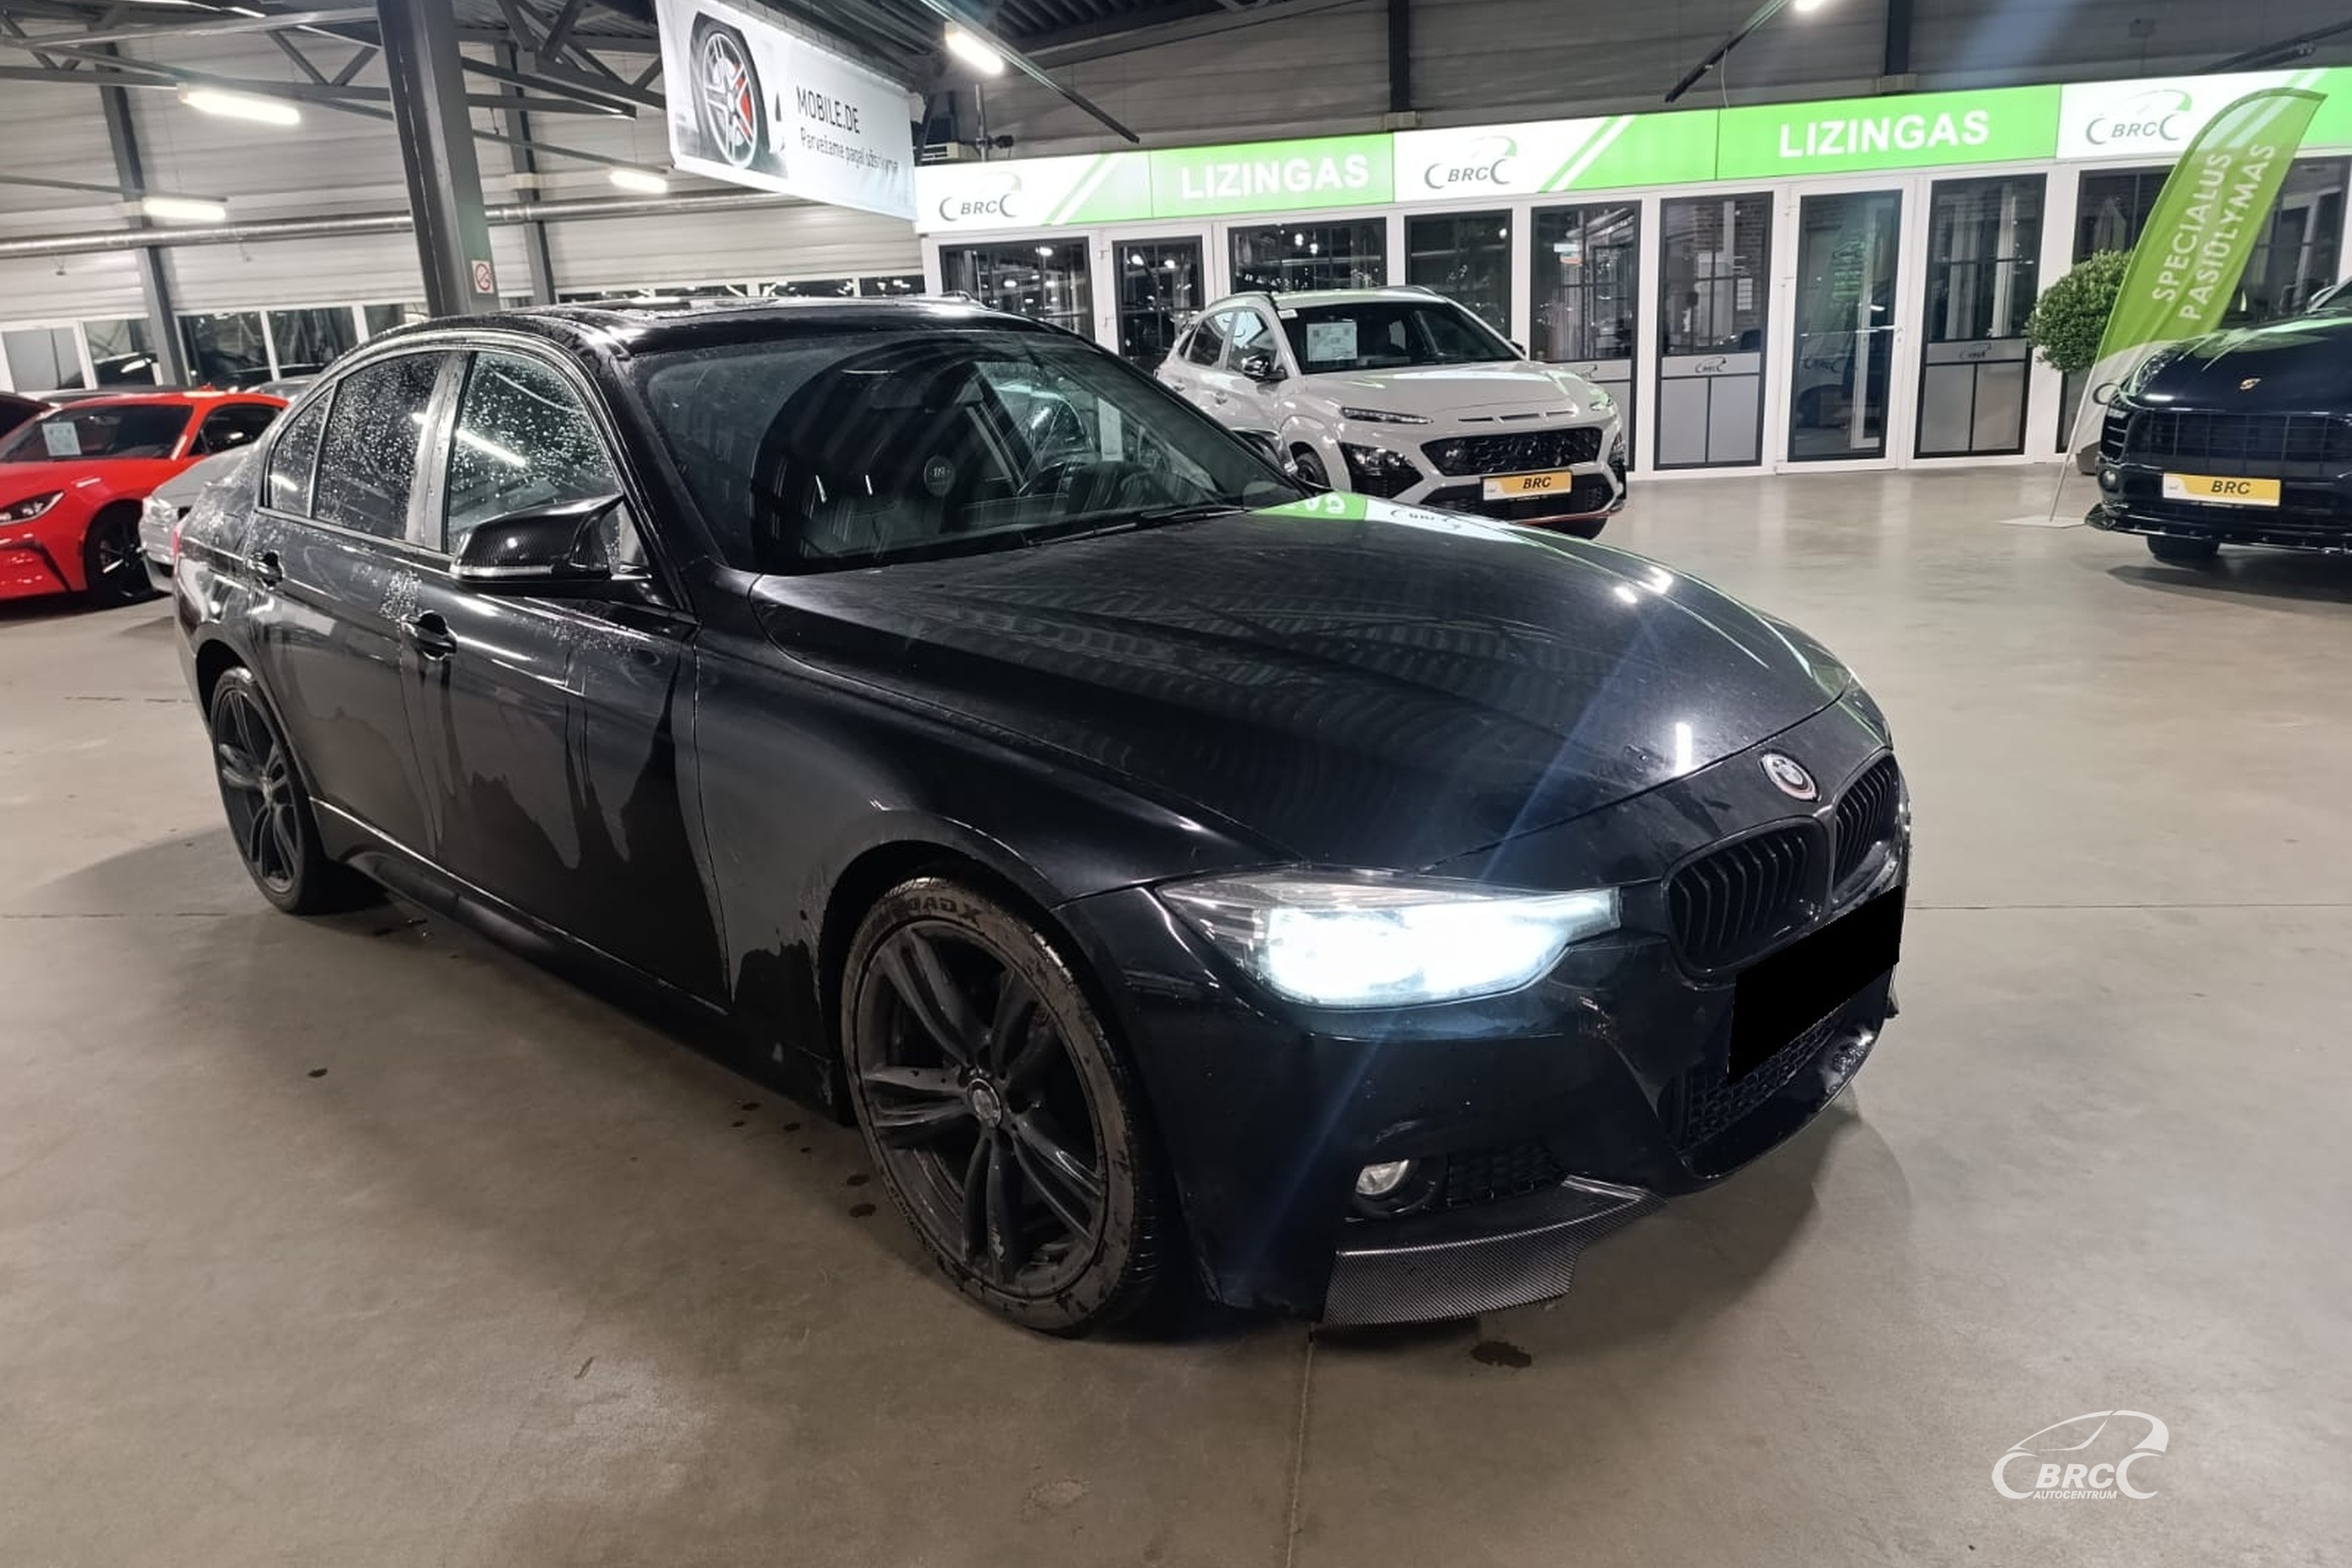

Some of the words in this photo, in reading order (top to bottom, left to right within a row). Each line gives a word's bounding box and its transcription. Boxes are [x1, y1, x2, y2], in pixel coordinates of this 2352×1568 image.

[796, 85, 860, 134] MOBILE.DE
[1778, 110, 1989, 158] LIZINGAS
[2111, 122, 2156, 138] BRC
[1180, 154, 1368, 199] LIZINGAS
[1448, 168, 1488, 183] BRC
[960, 200, 998, 215] BRC
[2152, 154, 2232, 302] SPECIALUS
[2178, 144, 2276, 320] PASIŪLYMAS
[1522, 476, 1551, 490] BRC
[2211, 480, 2251, 495] BRC
